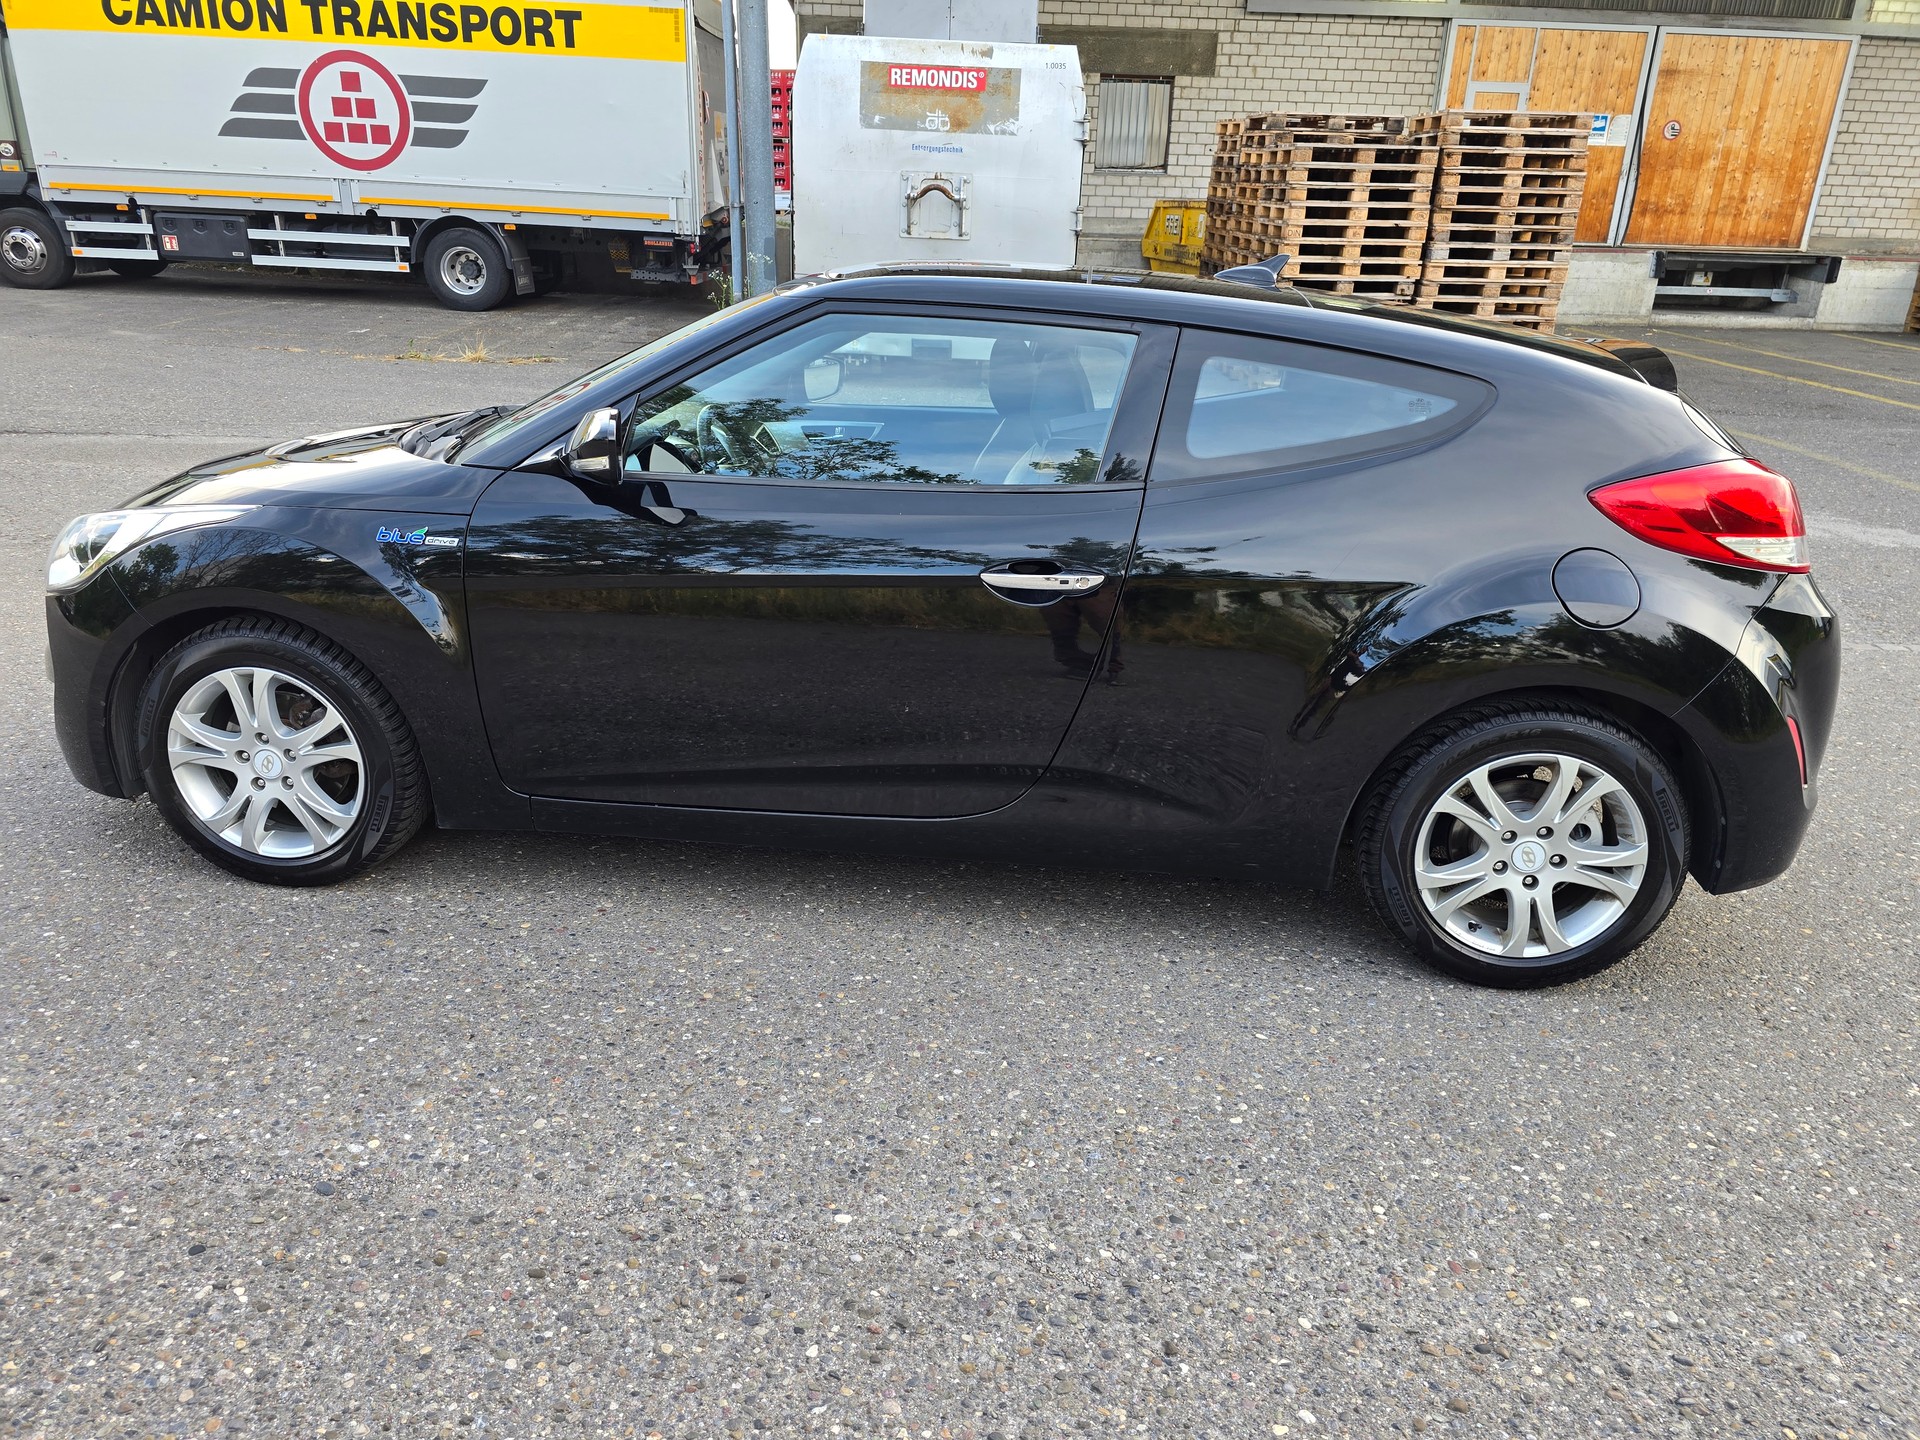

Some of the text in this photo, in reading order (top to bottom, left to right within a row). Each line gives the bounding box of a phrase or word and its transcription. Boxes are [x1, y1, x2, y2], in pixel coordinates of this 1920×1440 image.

[101, 0, 582, 48] CAMION TRANSPORT
[1045, 62, 1067, 70] 1.0035
[376, 526, 426, 545] blue
[369, 794, 389, 833] PIRELLI
[1655, 787, 1680, 833] PIRELLI
